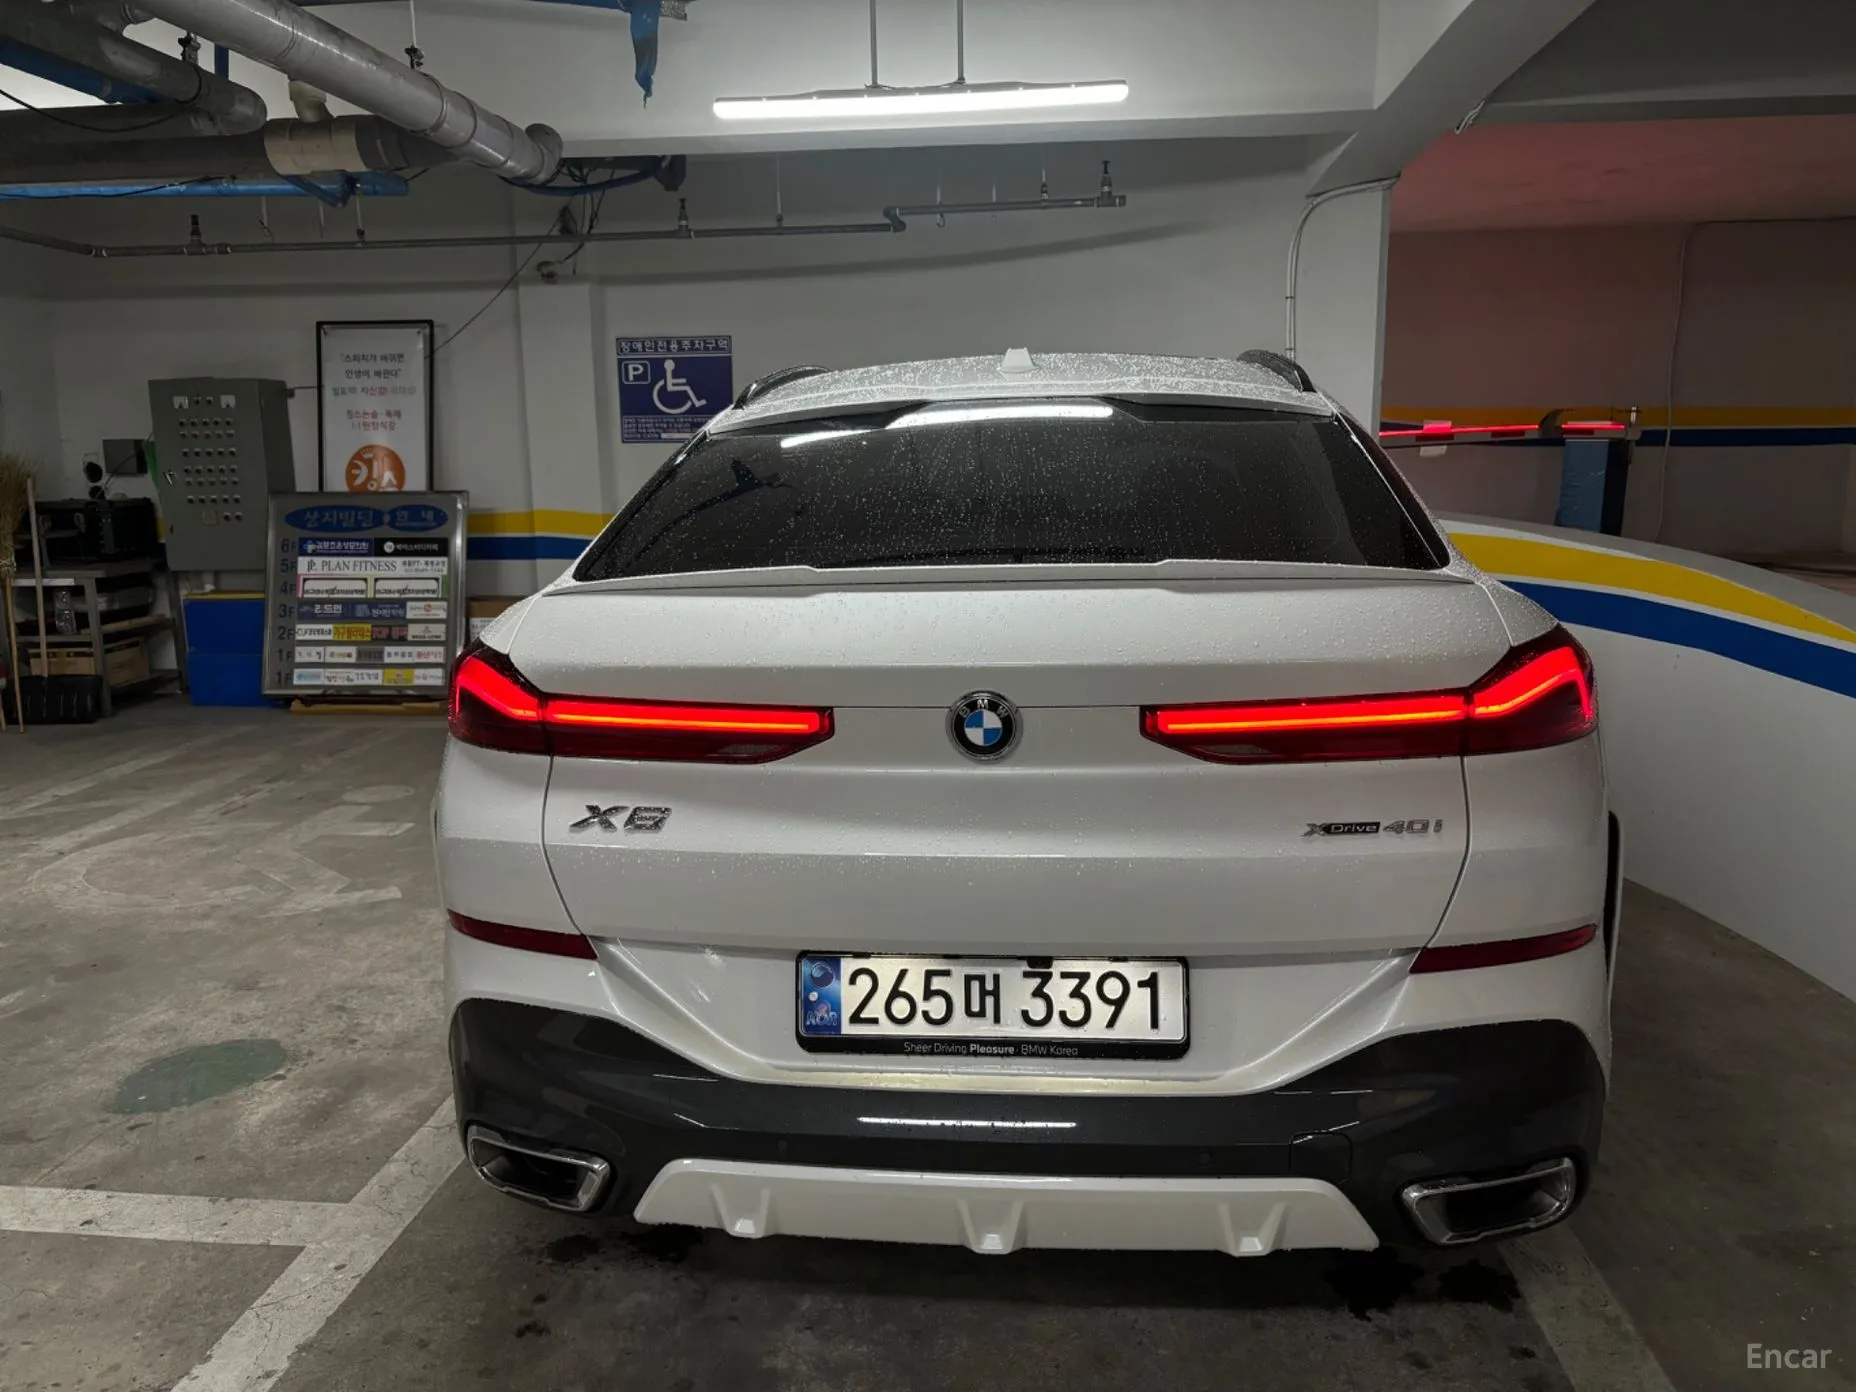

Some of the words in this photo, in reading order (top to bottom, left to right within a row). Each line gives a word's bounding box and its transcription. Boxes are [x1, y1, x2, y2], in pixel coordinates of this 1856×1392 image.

[620, 339, 729, 353] 장애인전용주차구역
[628, 364, 644, 381] P
[282, 539, 297, 552] 6F
[280, 559, 296, 573] 5F
[321, 560, 350, 572] PLAN
[353, 560, 397, 572] FITNESS
[279, 580, 296, 595] 4F
[278, 604, 295, 618] 3F
[278, 627, 294, 640] 2F
[276, 648, 293, 661] 1F
[276, 671, 293, 685] 1F
[958, 699, 1009, 718] BMW
[569, 804, 673, 833] X6
[848, 967, 1001, 1026] 265머
[1021, 970, 1160, 1030] 3391
[904, 1042, 932, 1054] Sheer
[934, 1042, 968, 1056] Driving
[969, 1043, 1015, 1055] Pleasure
[1021, 1044, 1047, 1055] BMW
[1049, 1044, 1078, 1056] Korea
